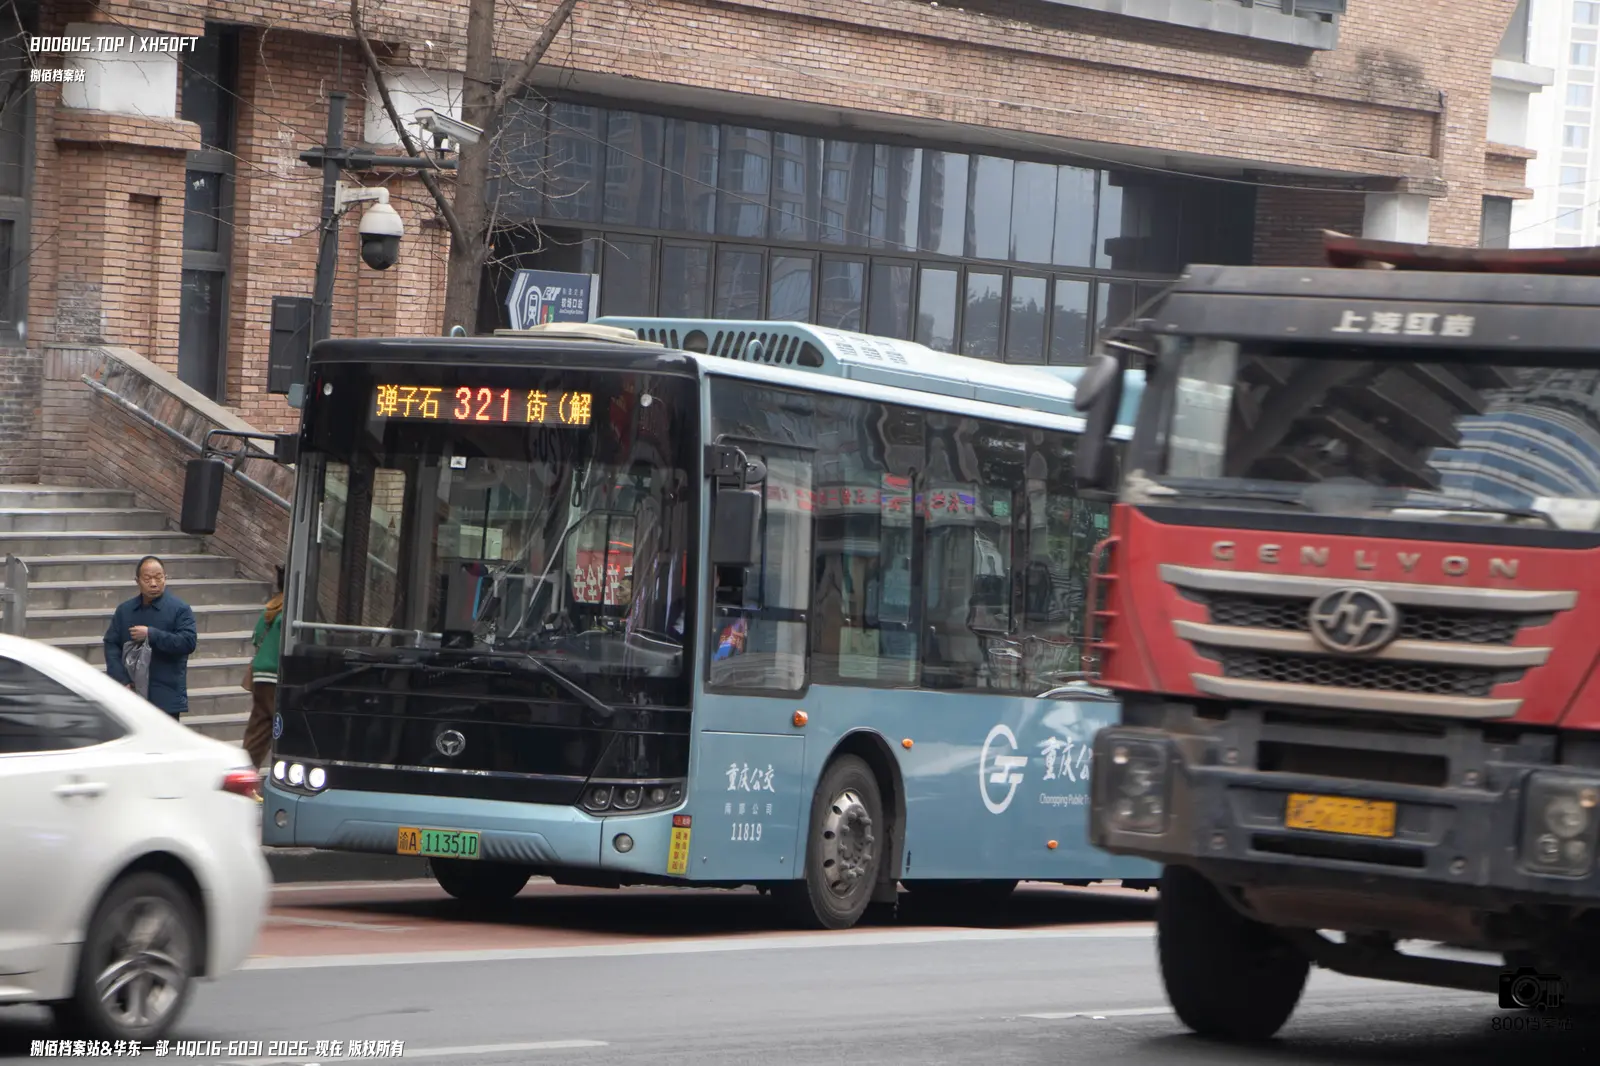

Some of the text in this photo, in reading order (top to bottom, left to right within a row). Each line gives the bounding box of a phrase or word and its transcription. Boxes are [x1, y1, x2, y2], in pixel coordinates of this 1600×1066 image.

[376, 384, 442, 418] 弹子石
[454, 386, 510, 421] 321
[1211, 540, 1520, 579] GENLYON
[725, 762, 776, 793] 重庆公交
[730, 822, 762, 841] 11819
